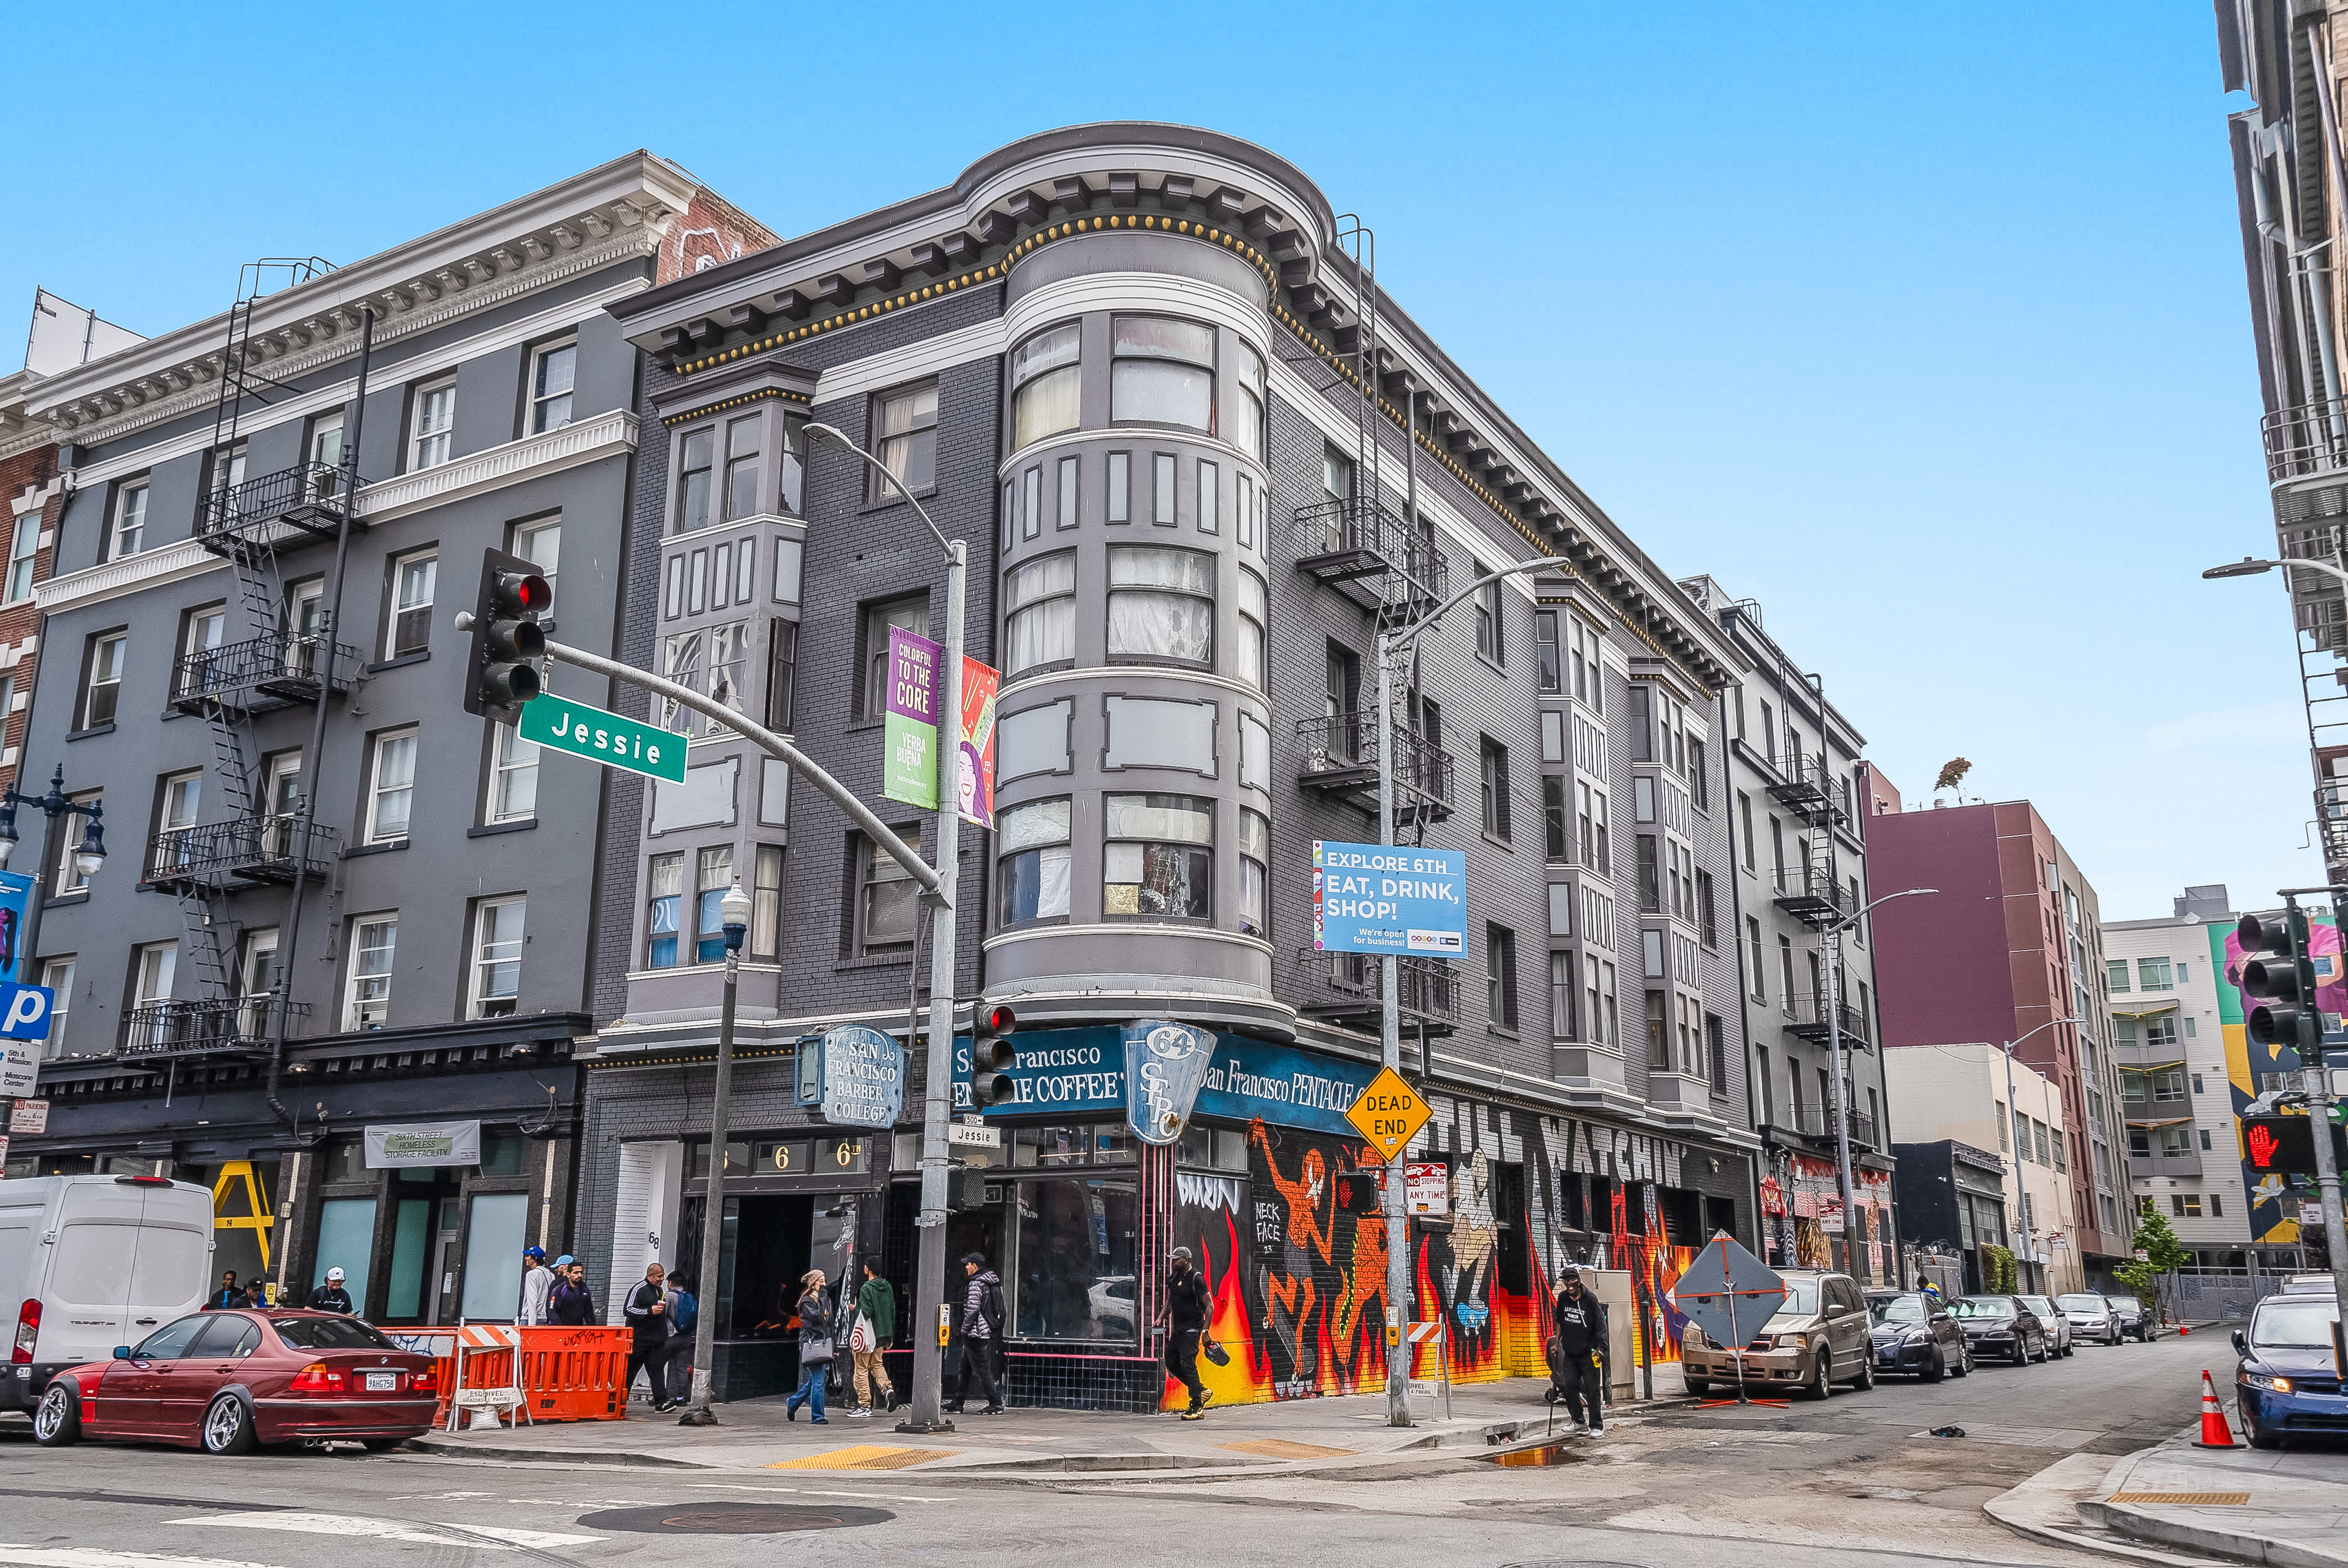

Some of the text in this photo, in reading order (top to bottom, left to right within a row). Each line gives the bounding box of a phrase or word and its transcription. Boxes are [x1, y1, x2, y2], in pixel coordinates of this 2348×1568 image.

[898, 643, 932, 667] COLORFUL
[898, 659, 930, 688] TO THE
[896, 681, 930, 715] CORE
[551, 713, 660, 764] Jessie
[902, 732, 926, 754] YERBA
[896, 746, 922, 771] BUENA
[1327, 852, 1446, 874] EXPLORE 6TH
[1327, 875, 1459, 904] EAT, DRINK,
[1327, 899, 1397, 920] SHOP!
[1367, 937, 1405, 946] business!
[1384, 930, 1404, 939] open
[849, 1041, 879, 1059] SAN
[1153, 1030, 1193, 1056] 64
[7, 1057, 32, 1066] Mission
[1014, 1047, 1101, 1069] rancisco
[4, 1072, 33, 1081] Moscone
[827, 1059, 896, 1082] FRANCISCO
[836, 1081, 883, 1101] BARBER
[1226, 1059, 1289, 1102] Francisco
[1290, 1073, 1355, 1112] PENTACLE
[834, 1101, 886, 1122] COLLEGE
[1367, 1095, 1412, 1111] DEAD
[966, 1115, 977, 1124] 500
[1375, 1119, 1406, 1135] END
[1406, 1095, 1523, 1163] TILL
[399, 1141, 436, 1149] HOMELESS
[958, 1129, 990, 1142] Jessie
[417, 1149, 448, 1157] FACILITY
[1427, 1191, 1445, 1199] TIME
[1256, 1202, 1280, 1221] NECK
[649, 1231, 659, 1249] 68
[1257, 1222, 1280, 1242] FACE
[1264, 1245, 1272, 1254] 23
[368, 1379, 394, 1388] 9AHG758
